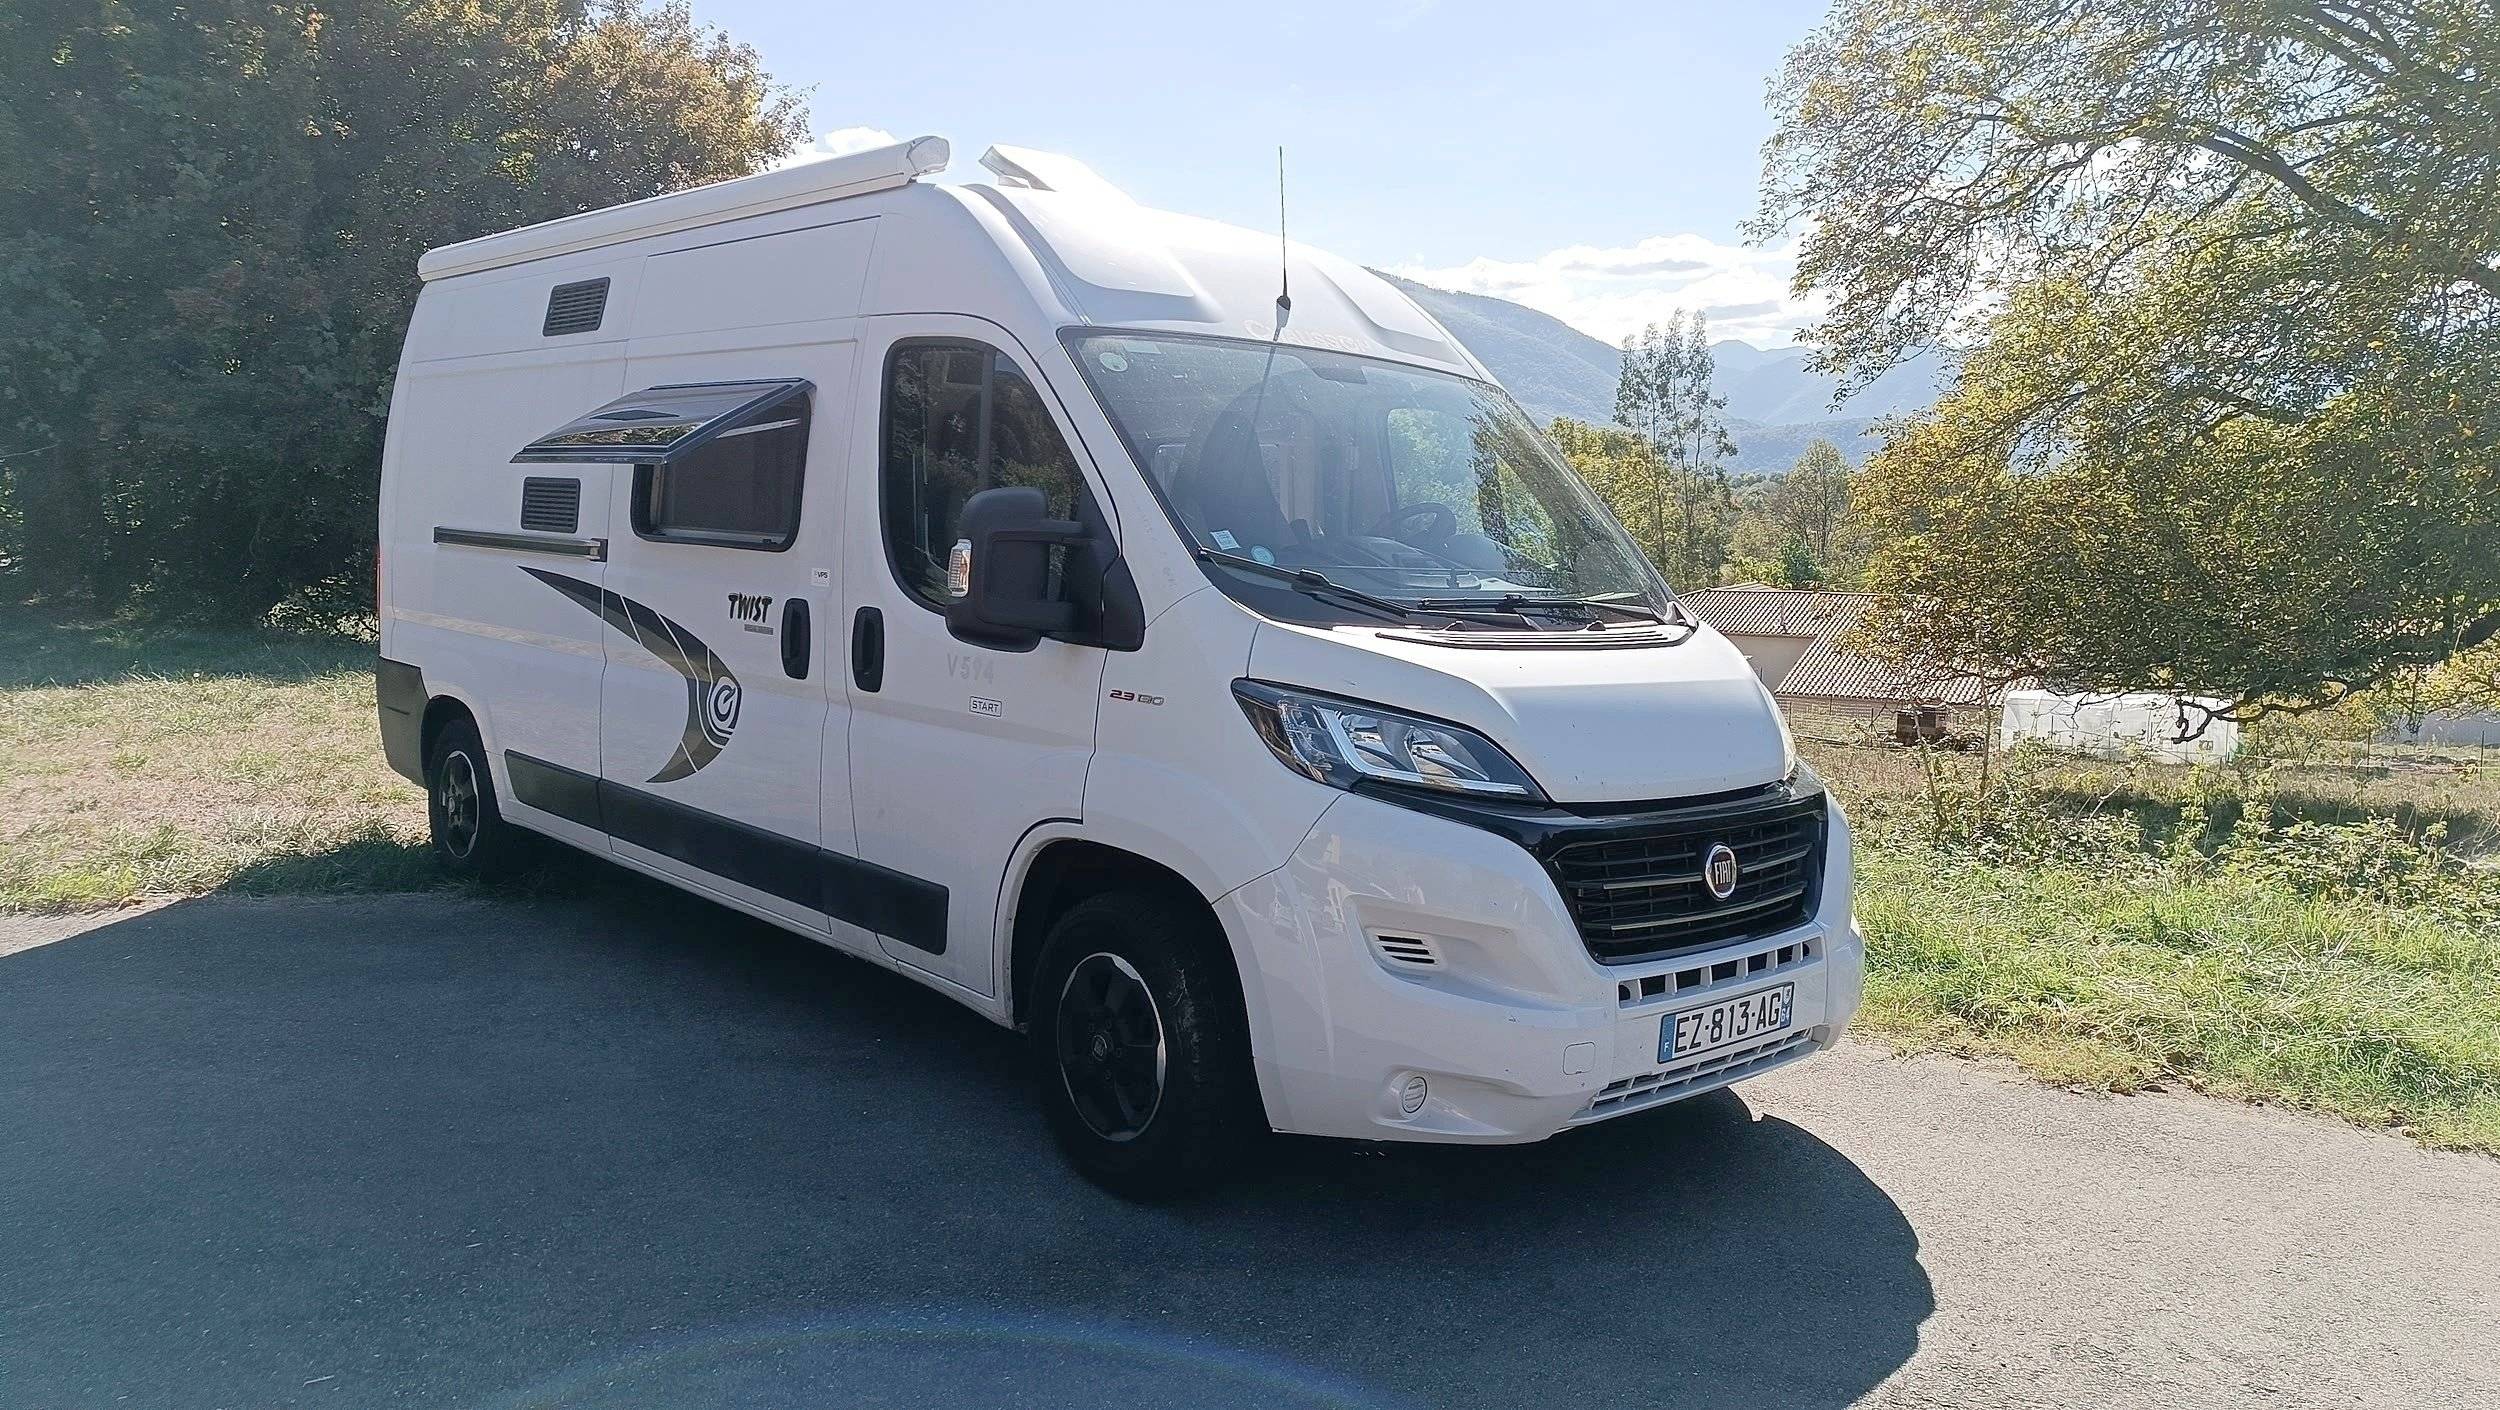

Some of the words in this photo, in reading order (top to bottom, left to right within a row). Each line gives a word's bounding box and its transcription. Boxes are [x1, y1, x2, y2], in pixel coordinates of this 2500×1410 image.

[728, 592, 773, 623] TWIST
[972, 700, 999, 713] START
[1714, 860, 1732, 884] FIAT
[1663, 1041, 1670, 1053] F
